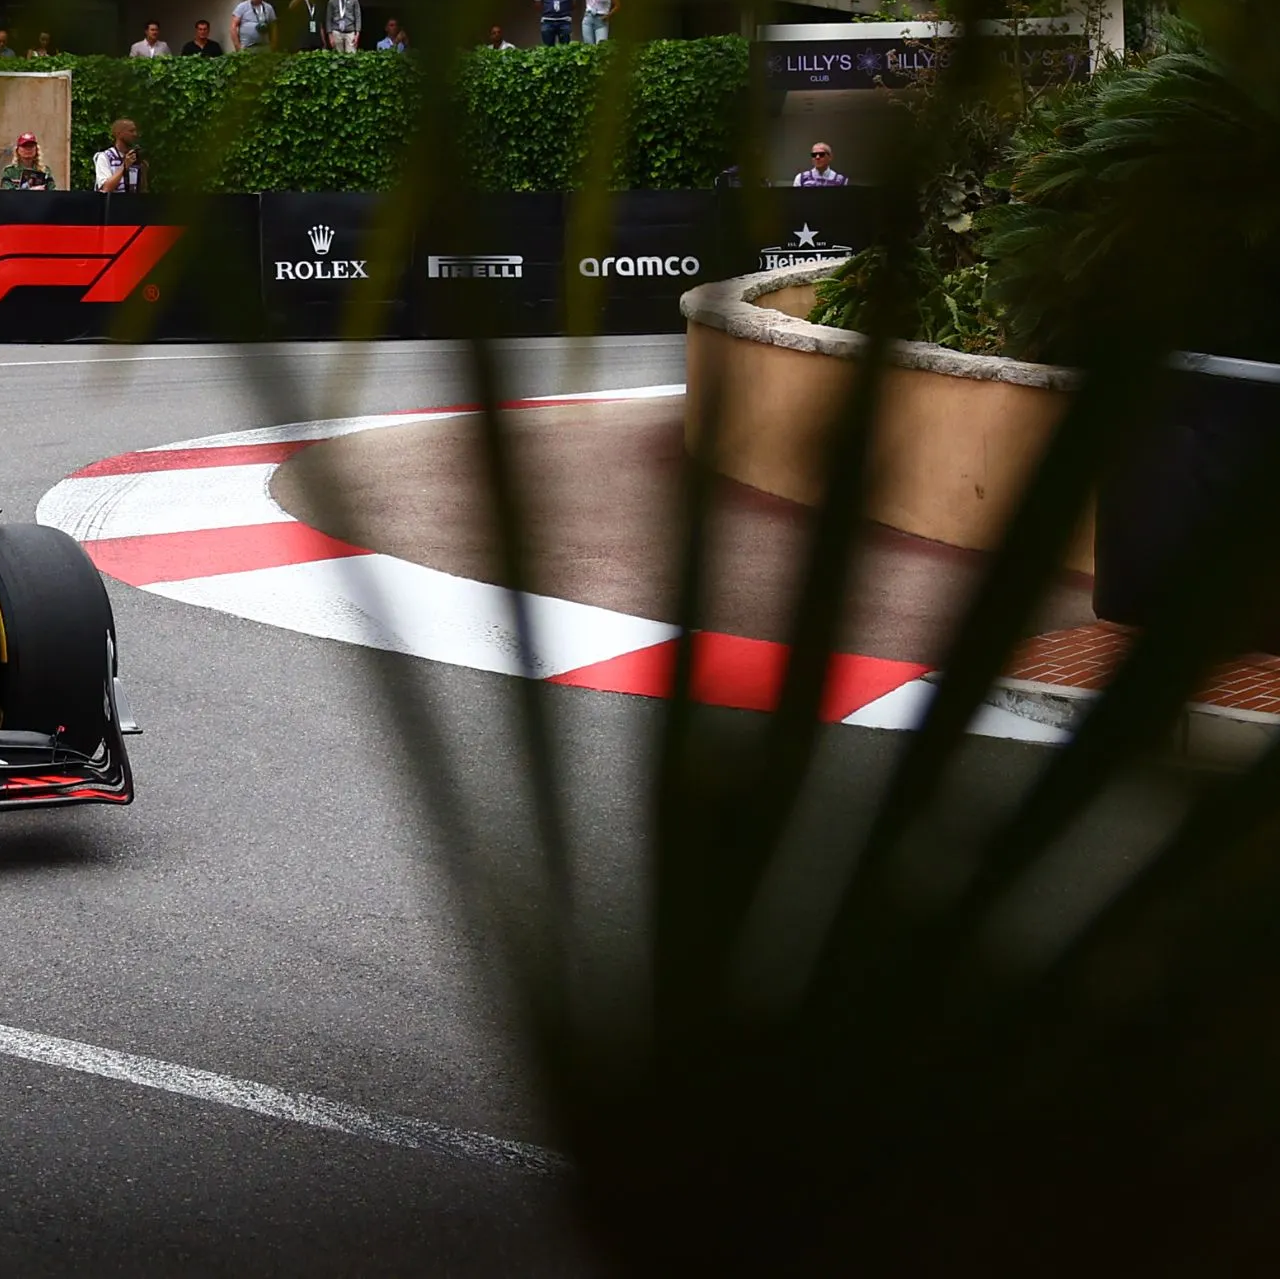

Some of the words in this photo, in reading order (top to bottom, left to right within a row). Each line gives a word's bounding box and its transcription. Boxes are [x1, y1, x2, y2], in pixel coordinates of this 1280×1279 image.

[787, 54, 852, 71] LILLY'S
[275, 260, 369, 280] ROLEX
[428, 255, 523, 278] PIRELLI
[579, 255, 700, 277] aramco
